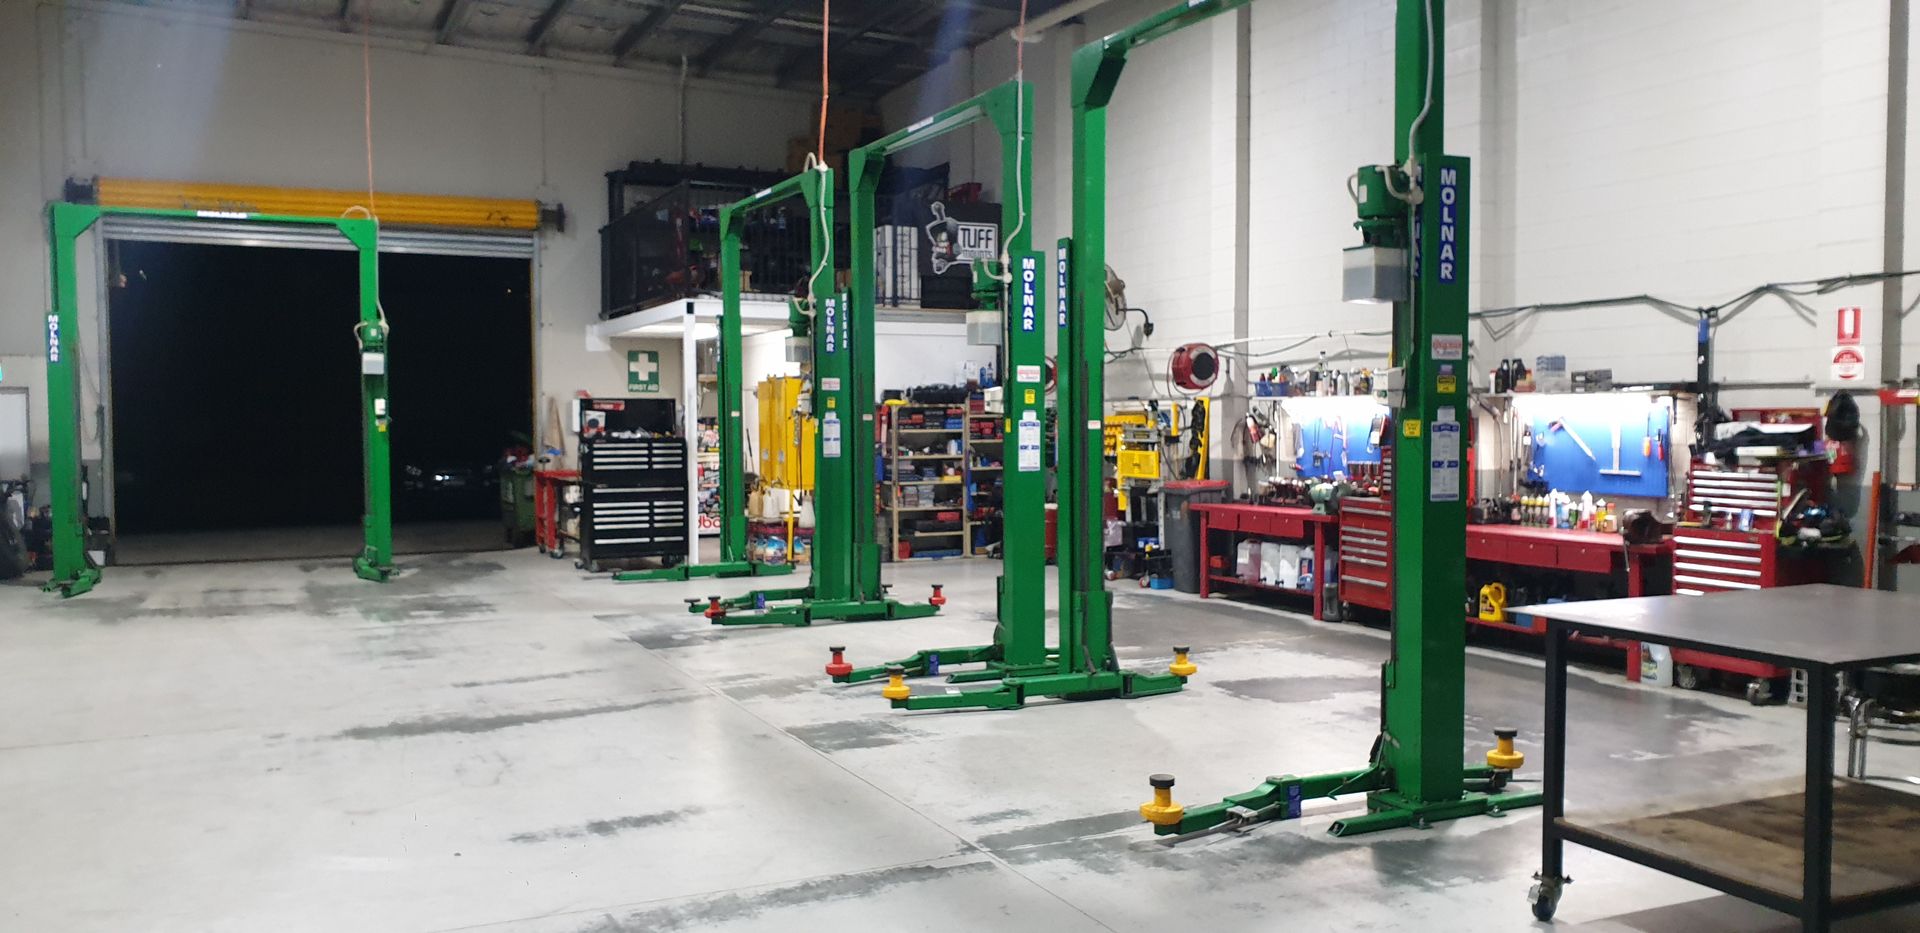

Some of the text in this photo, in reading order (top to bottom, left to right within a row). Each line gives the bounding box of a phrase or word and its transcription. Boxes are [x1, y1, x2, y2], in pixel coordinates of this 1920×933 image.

[960, 227, 993, 249] TUFF
[1440, 168, 1456, 280] MOLNAR
[1022, 258, 1035, 331] MOLNAR
[1058, 248, 1067, 325] MOLNAR
[48, 314, 59, 362] MOLNAR
[825, 298, 835, 352] MOLNAR
